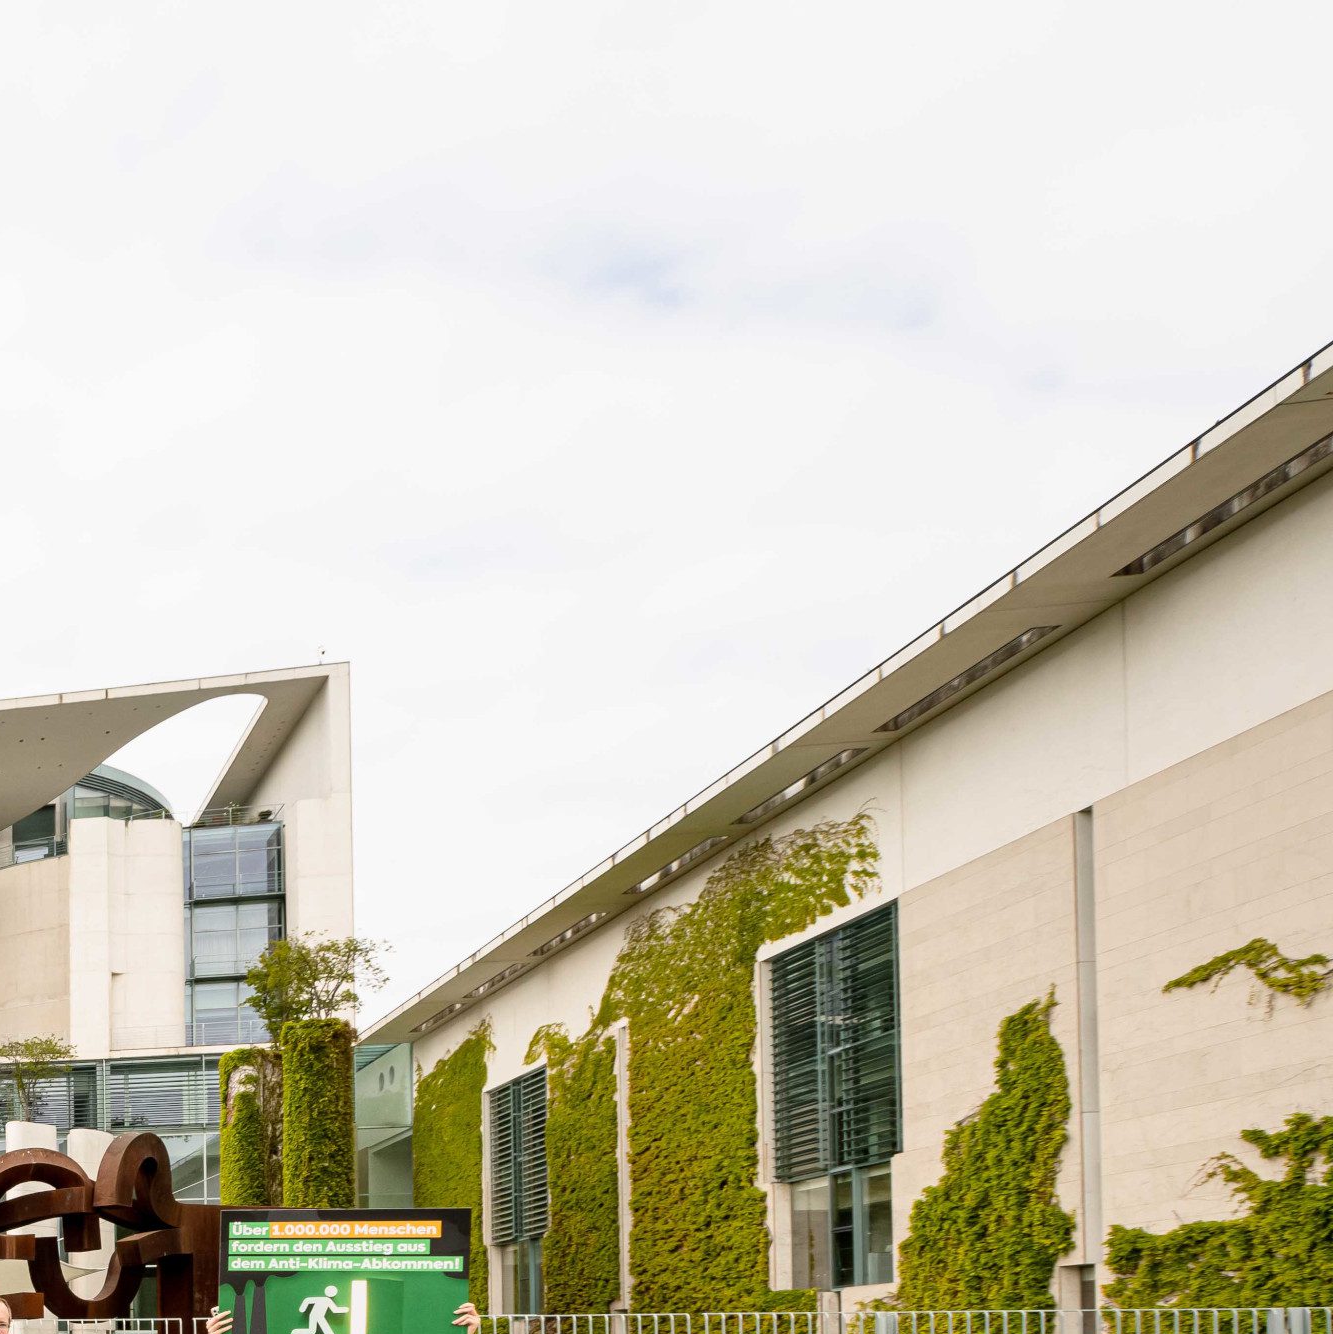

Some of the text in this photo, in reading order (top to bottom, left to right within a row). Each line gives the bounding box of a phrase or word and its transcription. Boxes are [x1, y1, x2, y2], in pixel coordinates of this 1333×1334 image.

[232, 1222, 437, 1236] Über 1.000.000 Menschen
[232, 1240, 426, 1255] fordern den Ausstieg aus
[231, 1256, 460, 1269] dem Anti-Klima-Abkommen!
